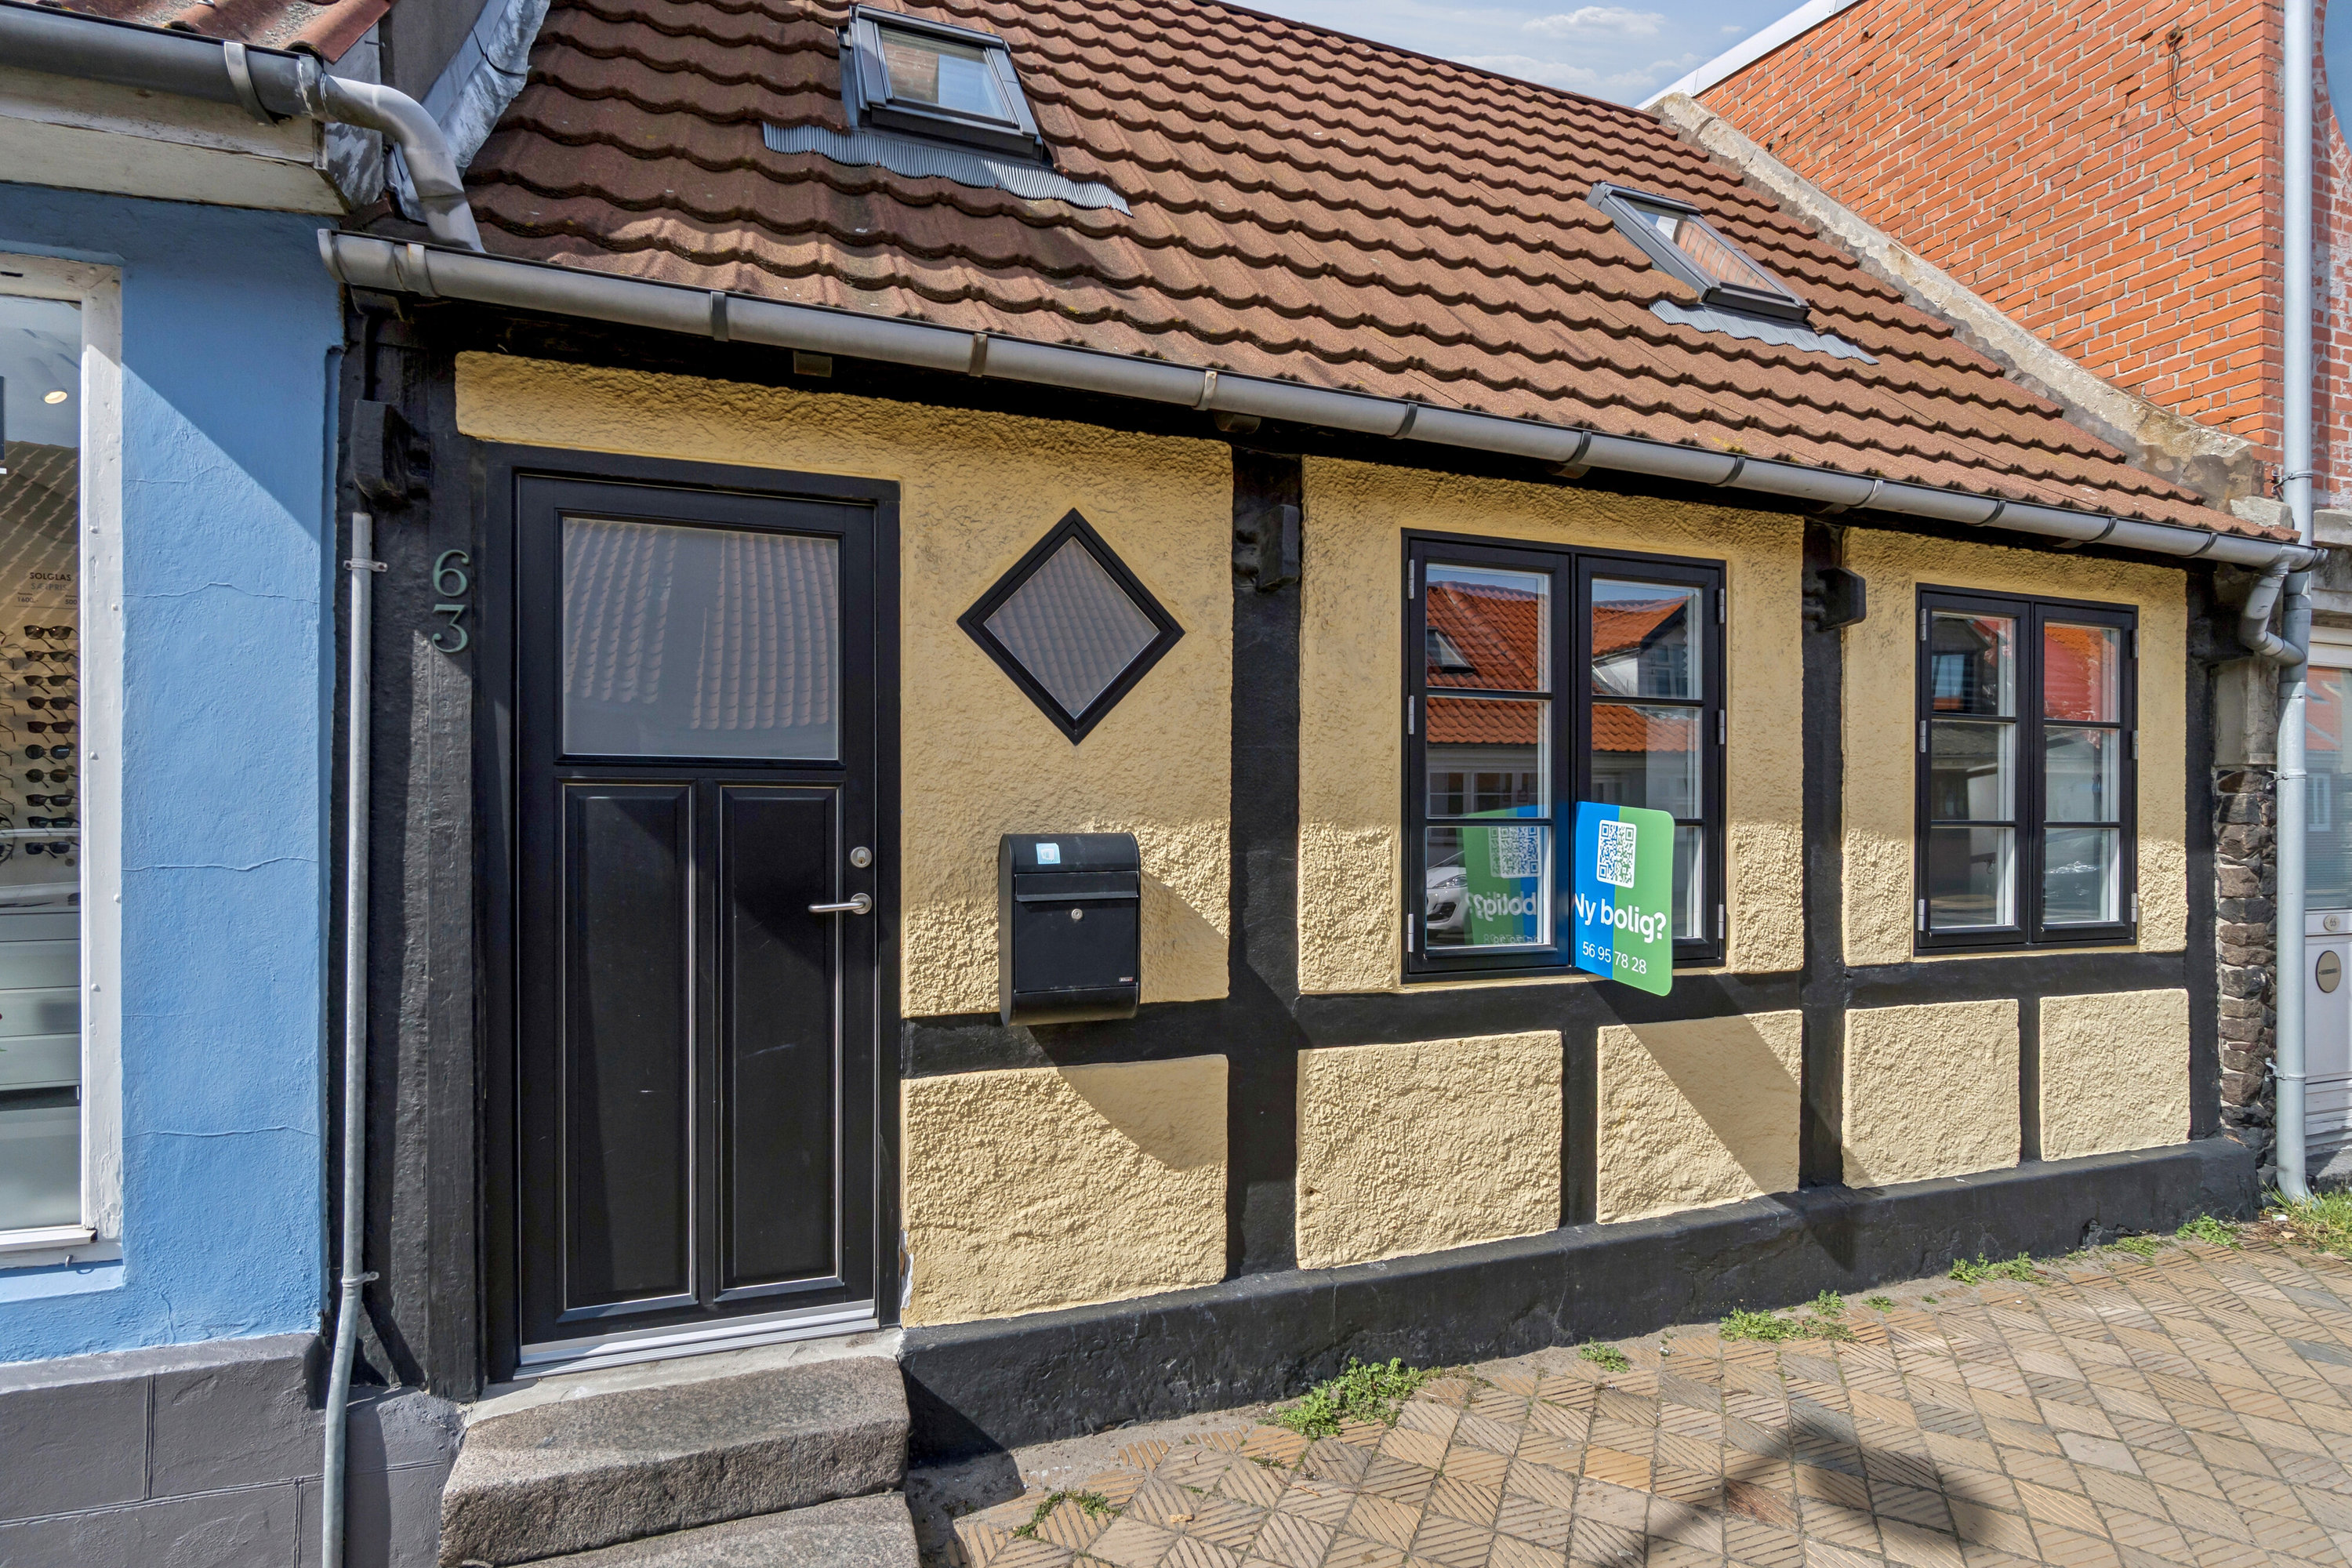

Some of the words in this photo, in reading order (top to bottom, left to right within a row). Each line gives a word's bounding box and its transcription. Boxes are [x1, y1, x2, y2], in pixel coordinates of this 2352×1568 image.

[30, 572, 71, 582] SOLGLAS
[432, 549, 469, 653] 63
[1575, 892, 1596, 926] Ny
[1600, 898, 1667, 943] bolig?
[1582, 941, 1595, 958] 56
[1597, 946, 1611, 963] 95
[1614, 950, 1628, 968] 78
[1632, 956, 1647, 975] 28
